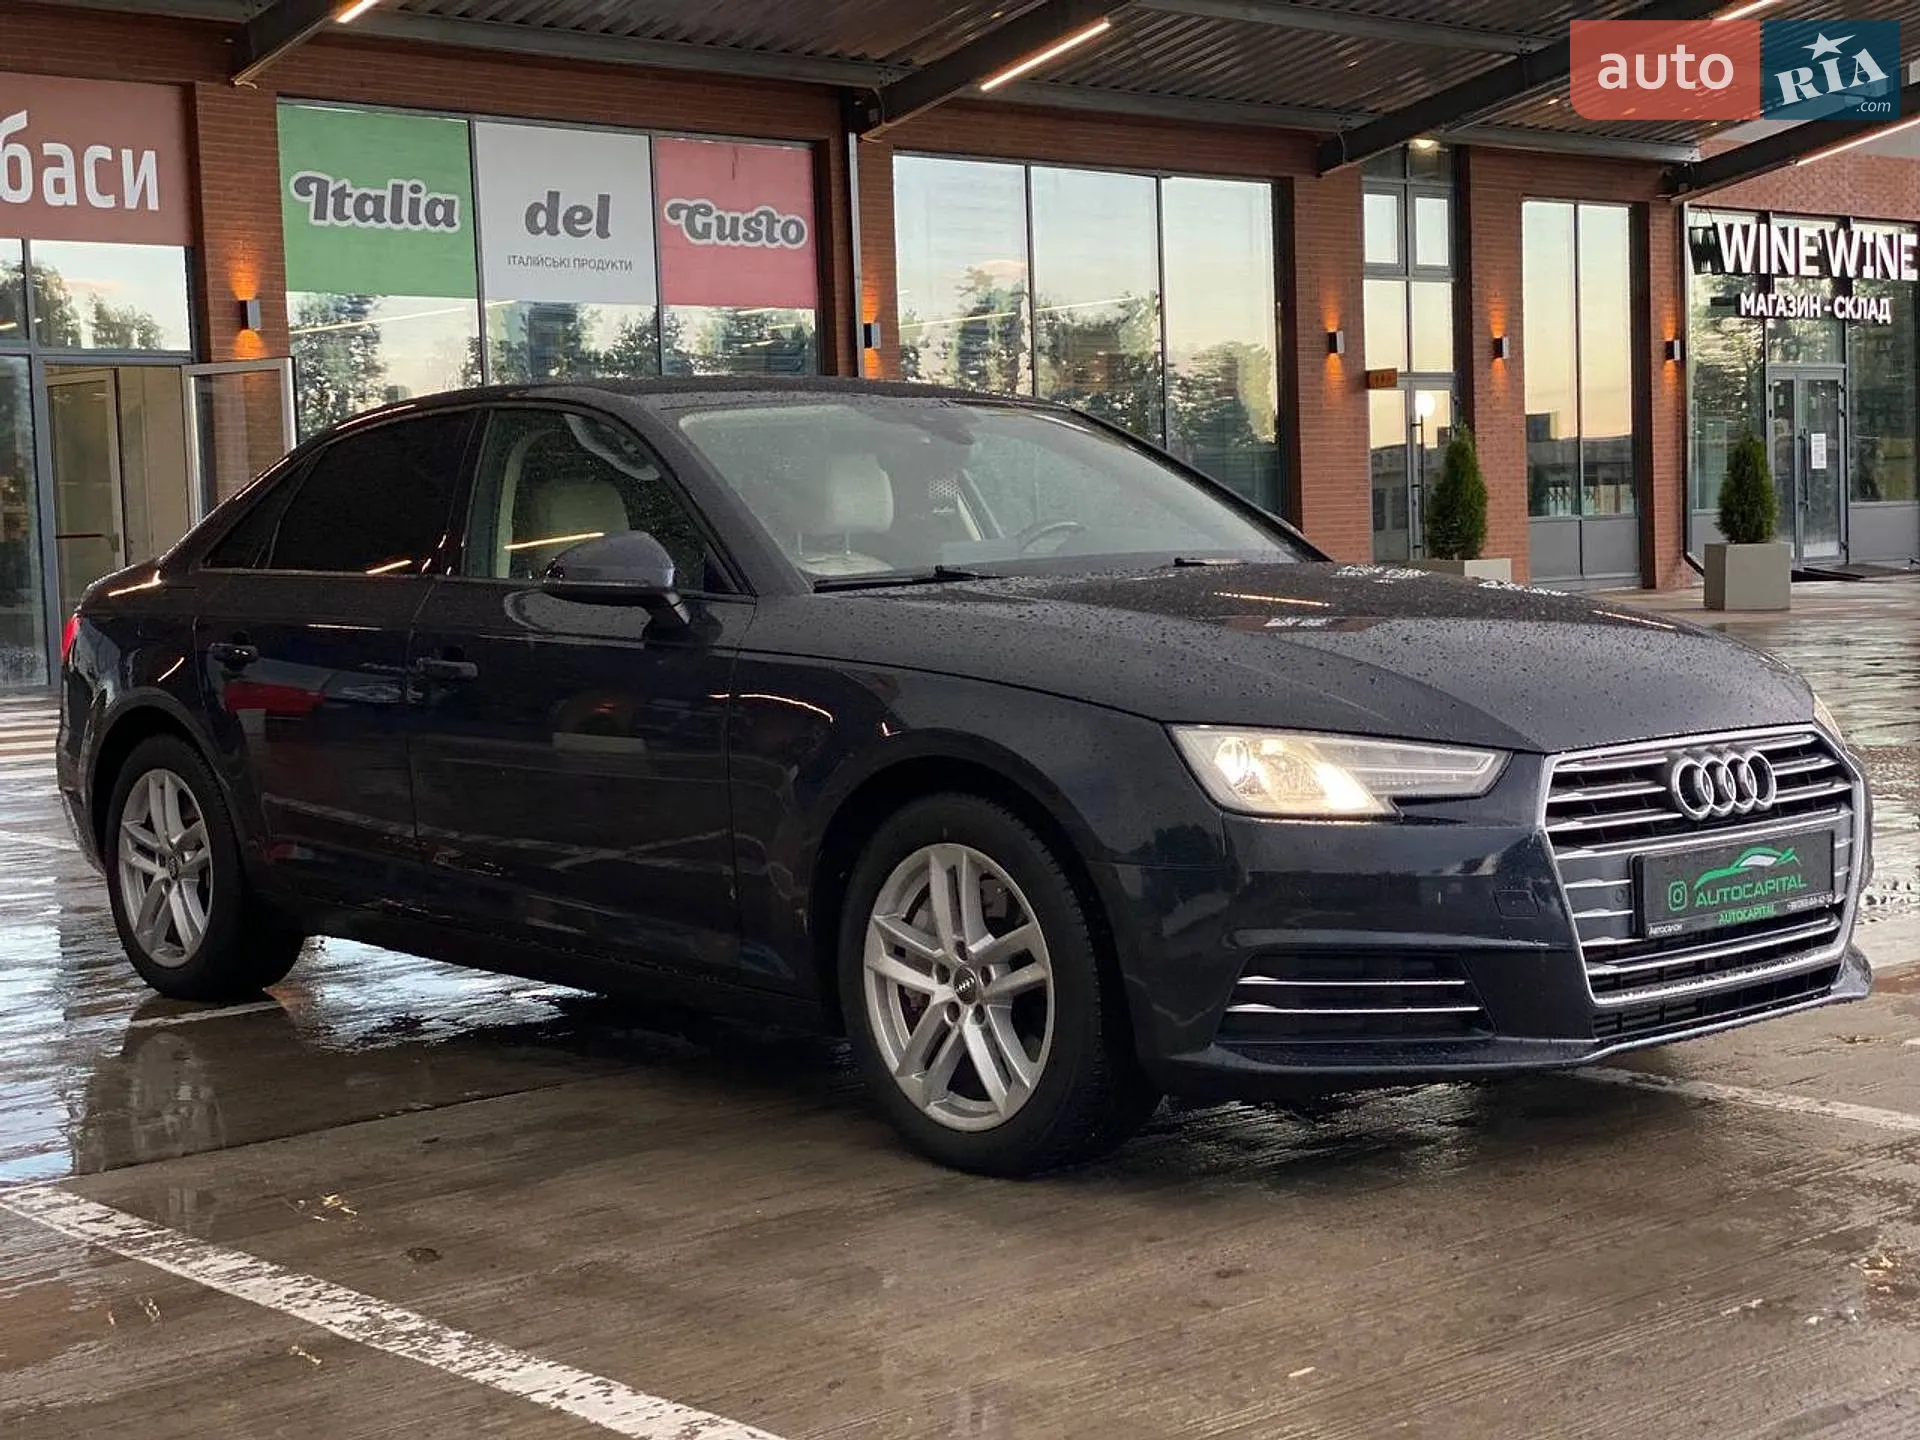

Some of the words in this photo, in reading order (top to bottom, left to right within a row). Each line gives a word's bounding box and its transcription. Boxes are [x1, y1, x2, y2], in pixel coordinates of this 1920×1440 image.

[0, 109, 160, 211] баси
[291, 172, 460, 232] Italia
[525, 191, 610, 240] del
[664, 199, 806, 249] Gusto
[572, 256, 633, 272] ПРОДУКТИ
[1695, 875, 1807, 907] AUTOCAPITAL
[1718, 904, 1777, 926] AUTOCAPITAL
